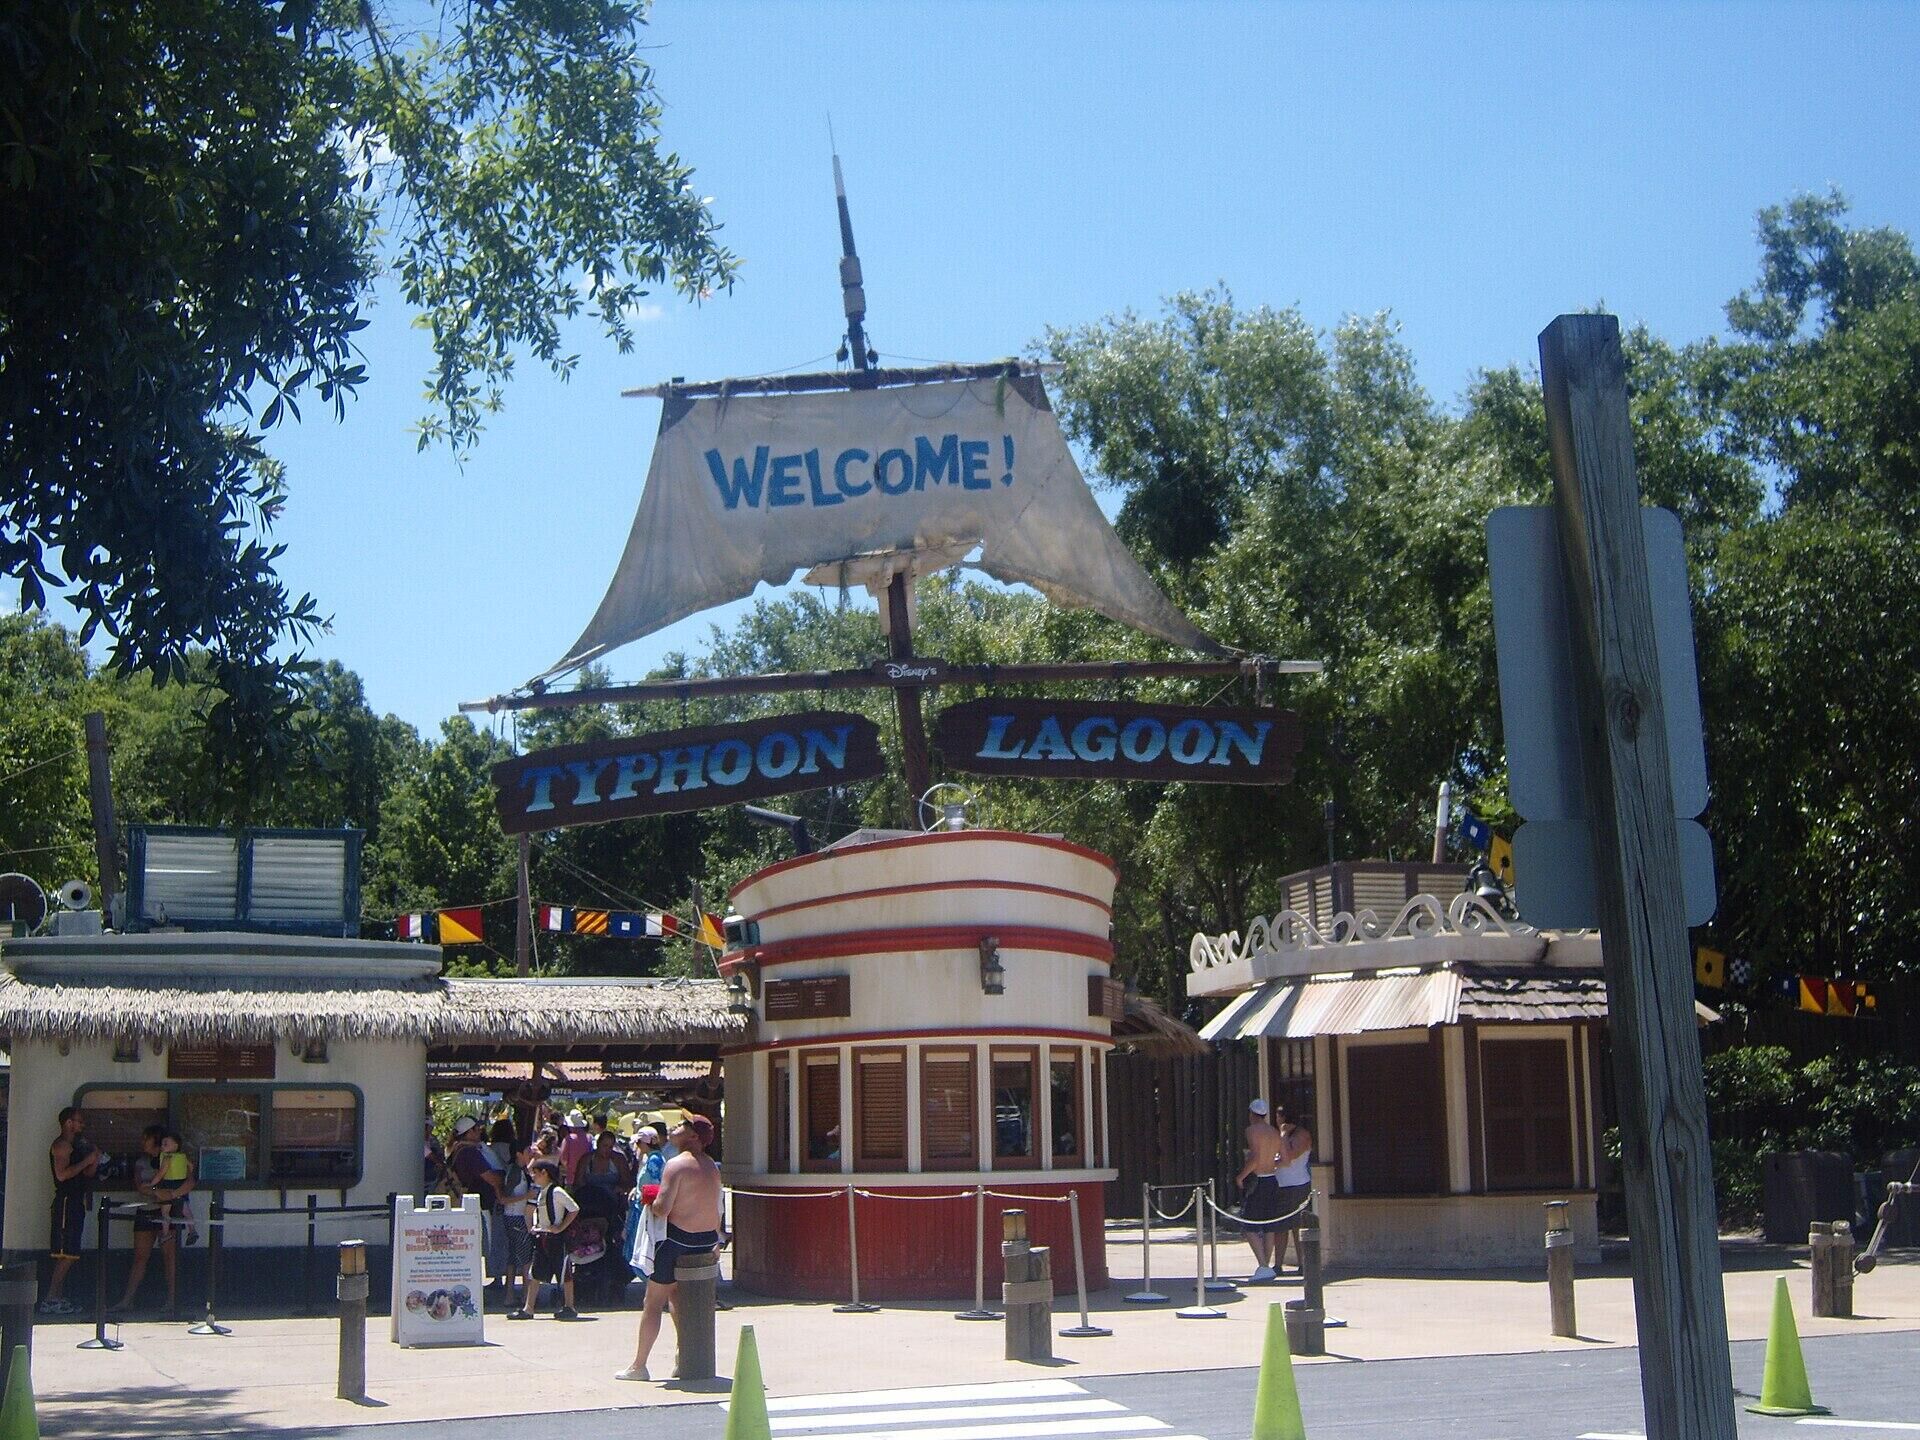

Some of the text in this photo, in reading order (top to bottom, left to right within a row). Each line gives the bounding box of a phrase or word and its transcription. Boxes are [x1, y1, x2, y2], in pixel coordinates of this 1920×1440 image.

[704, 434, 1015, 510] WELCOME!
[885, 663, 937, 681] Disney's
[519, 724, 854, 813] TYPHOON
[976, 714, 1274, 766] LAGOON
